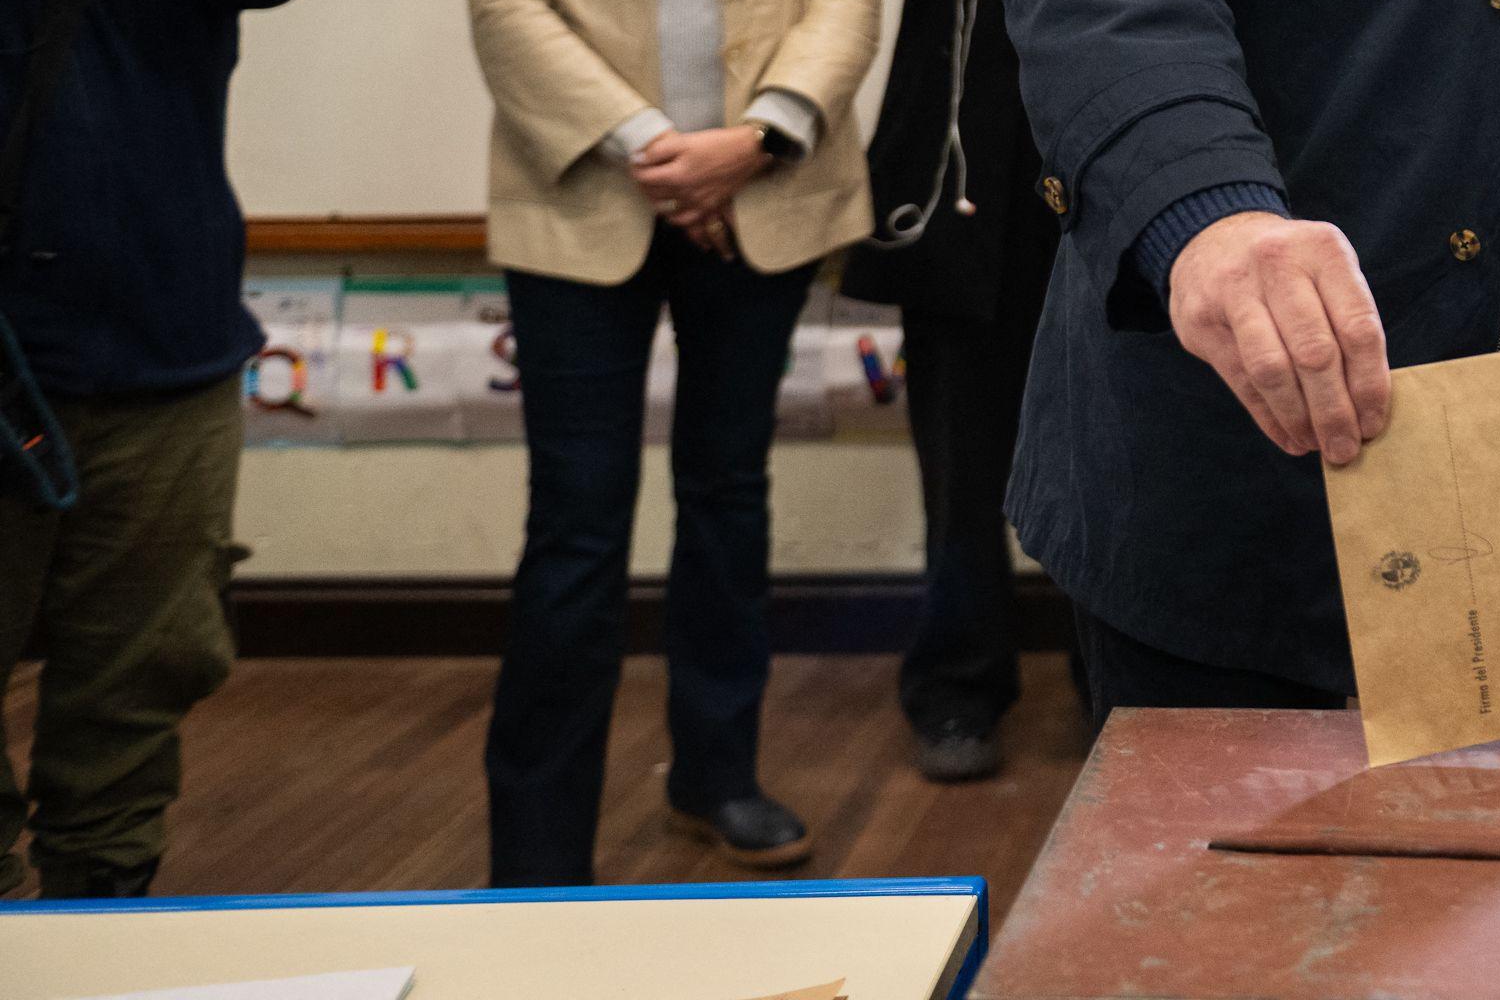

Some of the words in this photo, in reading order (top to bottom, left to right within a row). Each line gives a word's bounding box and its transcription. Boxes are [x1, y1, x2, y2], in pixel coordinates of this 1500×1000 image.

[370, 327, 417, 392] R
[1467, 609, 1484, 662] Presidente
[1472, 665, 1488, 681] del
[1480, 684, 1492, 714] Firma
